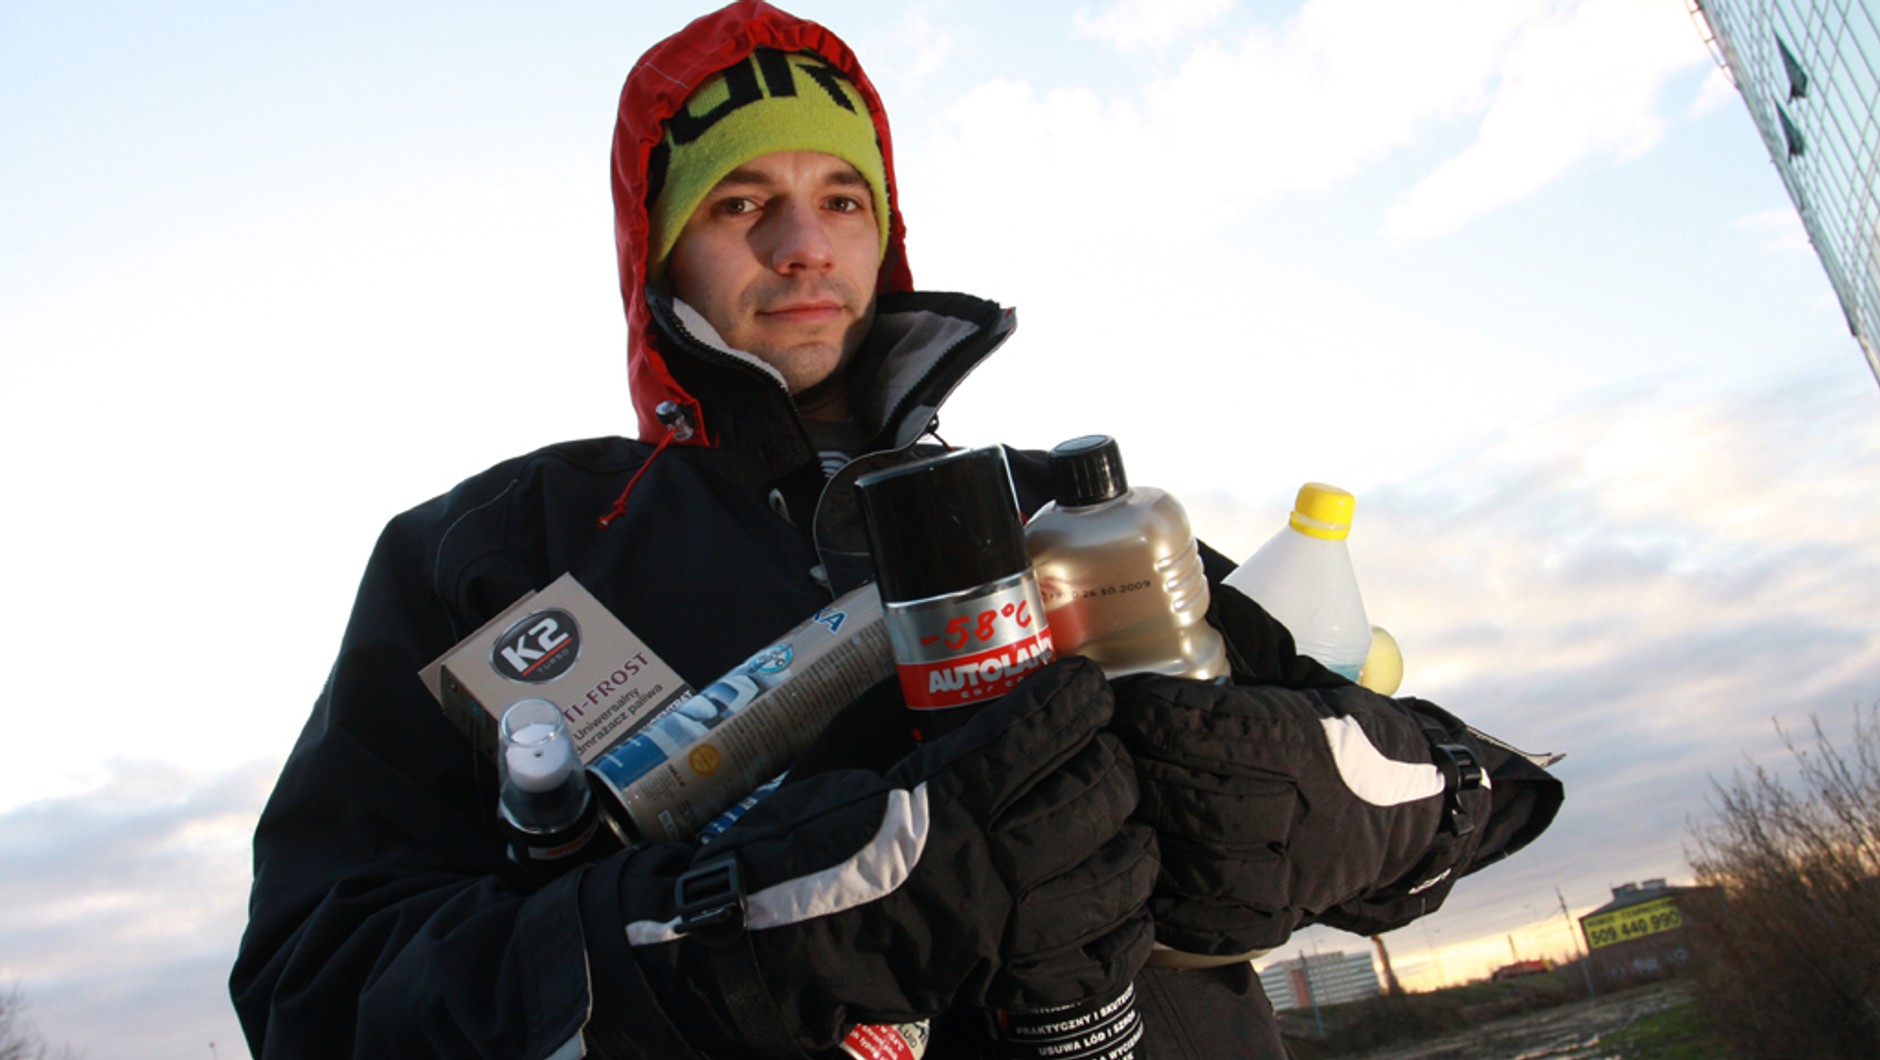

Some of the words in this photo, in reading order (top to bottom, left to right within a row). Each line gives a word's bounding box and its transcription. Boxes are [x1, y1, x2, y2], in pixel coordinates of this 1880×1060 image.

[501, 617, 570, 673] K2
[563, 651, 649, 724] TI-FROST
[573, 687, 640, 741] Uniwersalny
[576, 711, 629, 755] dmrażacz
[627, 683, 664, 716] paliwa
[1621, 916, 1649, 936] 440
[1016, 1014, 1092, 1034] PRAKTYCZNY
[1093, 1010, 1100, 1021] I
[1038, 1041, 1082, 1056] USUWA
